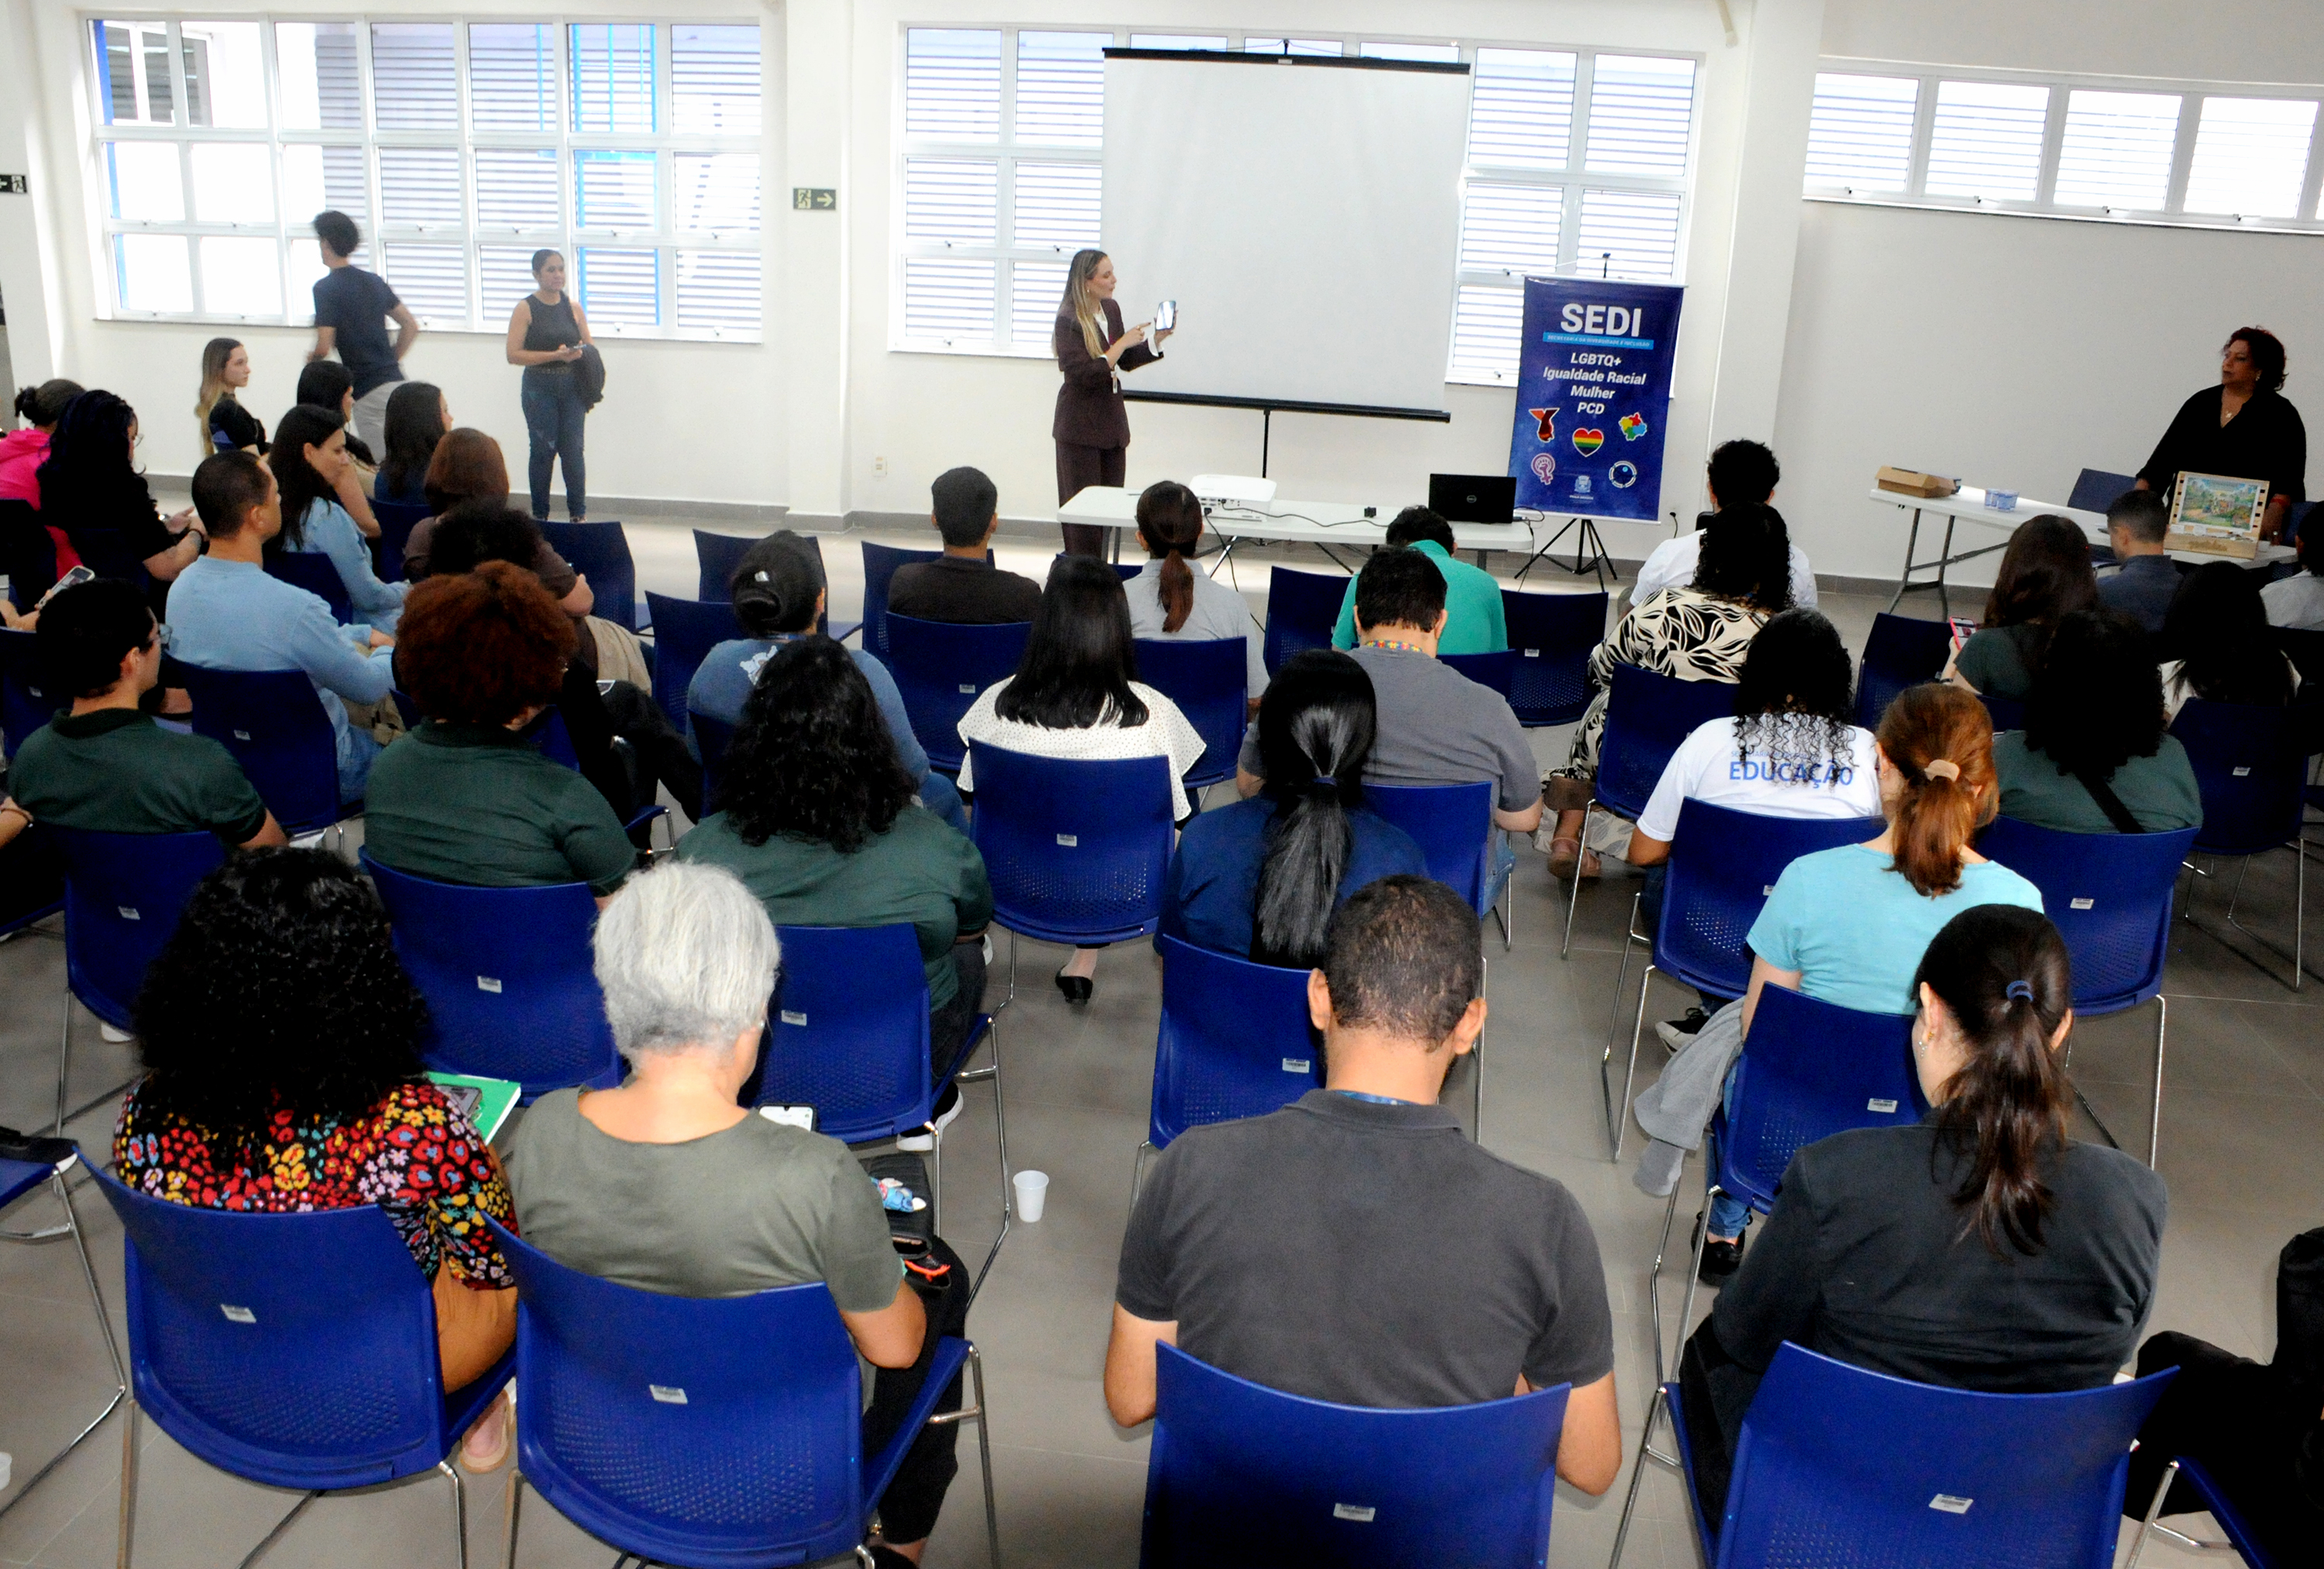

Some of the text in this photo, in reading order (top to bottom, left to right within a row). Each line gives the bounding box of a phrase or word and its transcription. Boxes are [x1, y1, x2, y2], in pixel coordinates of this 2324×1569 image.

[1560, 303, 1642, 337] SEDI
[1570, 353, 1621, 367] LGBTQ+
[1543, 366, 1646, 385] Igualdade Racial
[1570, 385, 1615, 399] Mulher
[1577, 402, 1605, 415] PCD
[1729, 759, 1854, 789] EDUCAÇÃO
